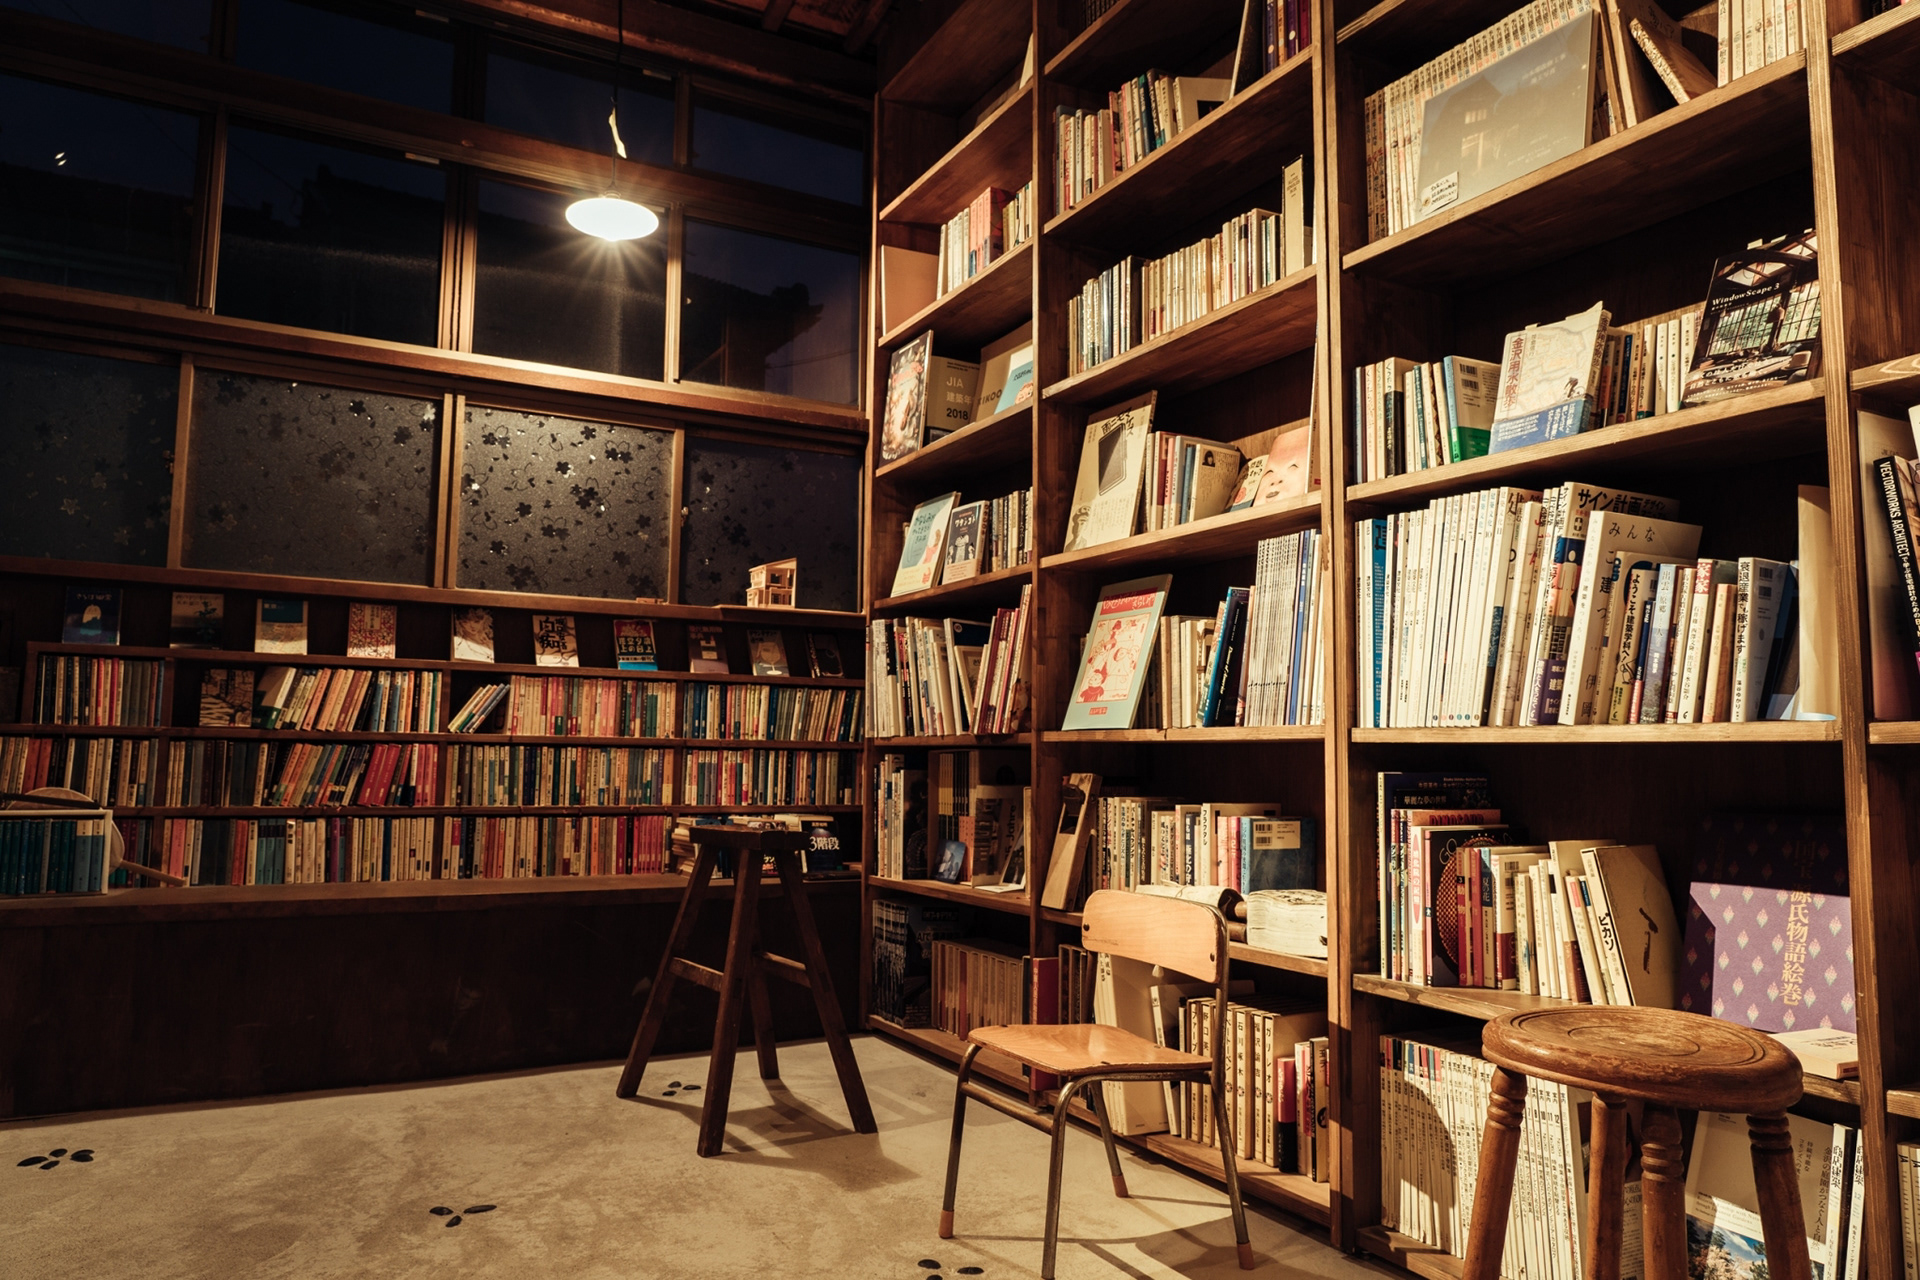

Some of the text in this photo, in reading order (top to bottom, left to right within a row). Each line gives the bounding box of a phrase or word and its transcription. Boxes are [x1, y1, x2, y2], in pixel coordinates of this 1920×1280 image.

[1711, 282, 1780, 306] WindowScape 3
[946, 377, 964, 388] JIA
[1503, 336, 1525, 410] 金沢用水散歩
[946, 408, 969, 421] 2018
[1578, 488, 1643, 515] サイン計画
[1879, 461, 1911, 558] VECTORWORKS ARCHITECT
[1621, 574, 1641, 662] ようこそ建築学科へ!
[1736, 561, 1751, 655] 衰退産業でも稼げます
[538, 617, 560, 649] 白痴
[1404, 795, 1447, 806] 華麗な夢の世界
[1008, 804, 1017, 841] Jahre
[1429, 814, 1485, 826] DINOSAUR
[1598, 911, 1616, 952] ピカソ
[1810, 1146, 1832, 1251] 金沢の庭園がつなぐ人と自然
